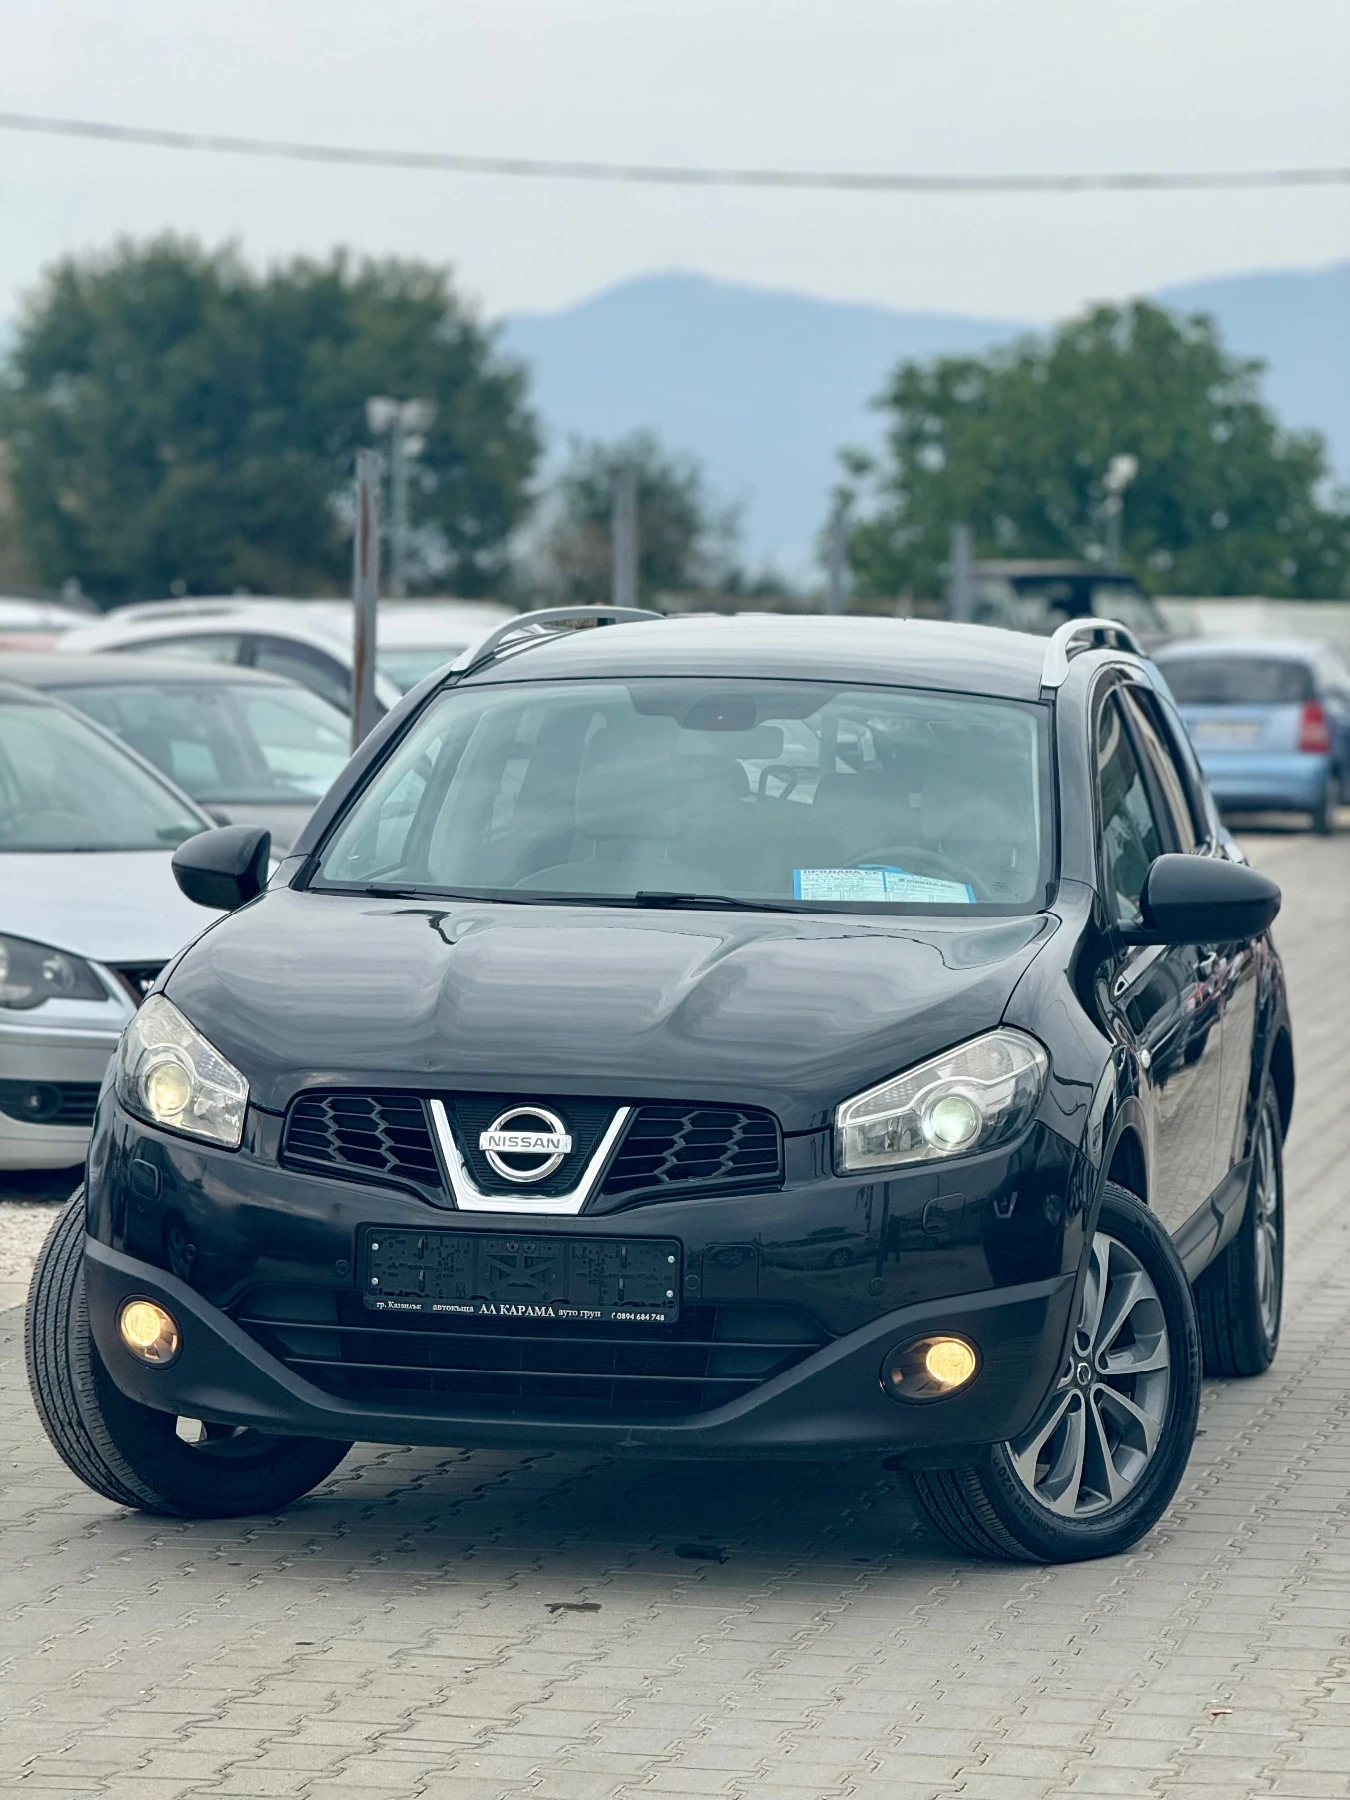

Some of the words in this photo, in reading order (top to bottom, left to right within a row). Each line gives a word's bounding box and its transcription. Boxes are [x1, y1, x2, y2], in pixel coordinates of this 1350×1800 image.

[488, 1135, 561, 1149] NISSAN
[376, 1301, 386, 1310] гр.
[387, 1300, 422, 1310] Казанлък
[432, 1304, 474, 1313] автокъща
[479, 1303, 498, 1315] АЛ
[500, 1304, 555, 1317] КАРАМА
[558, 1309, 578, 1318] ауто
[580, 1310, 601, 1319] груп
[616, 1312, 635, 1321] 0894
[636, 1312, 650, 1321] 684
[651, 1313, 665, 1322] 748
[997, 1465, 1016, 1496] 520
